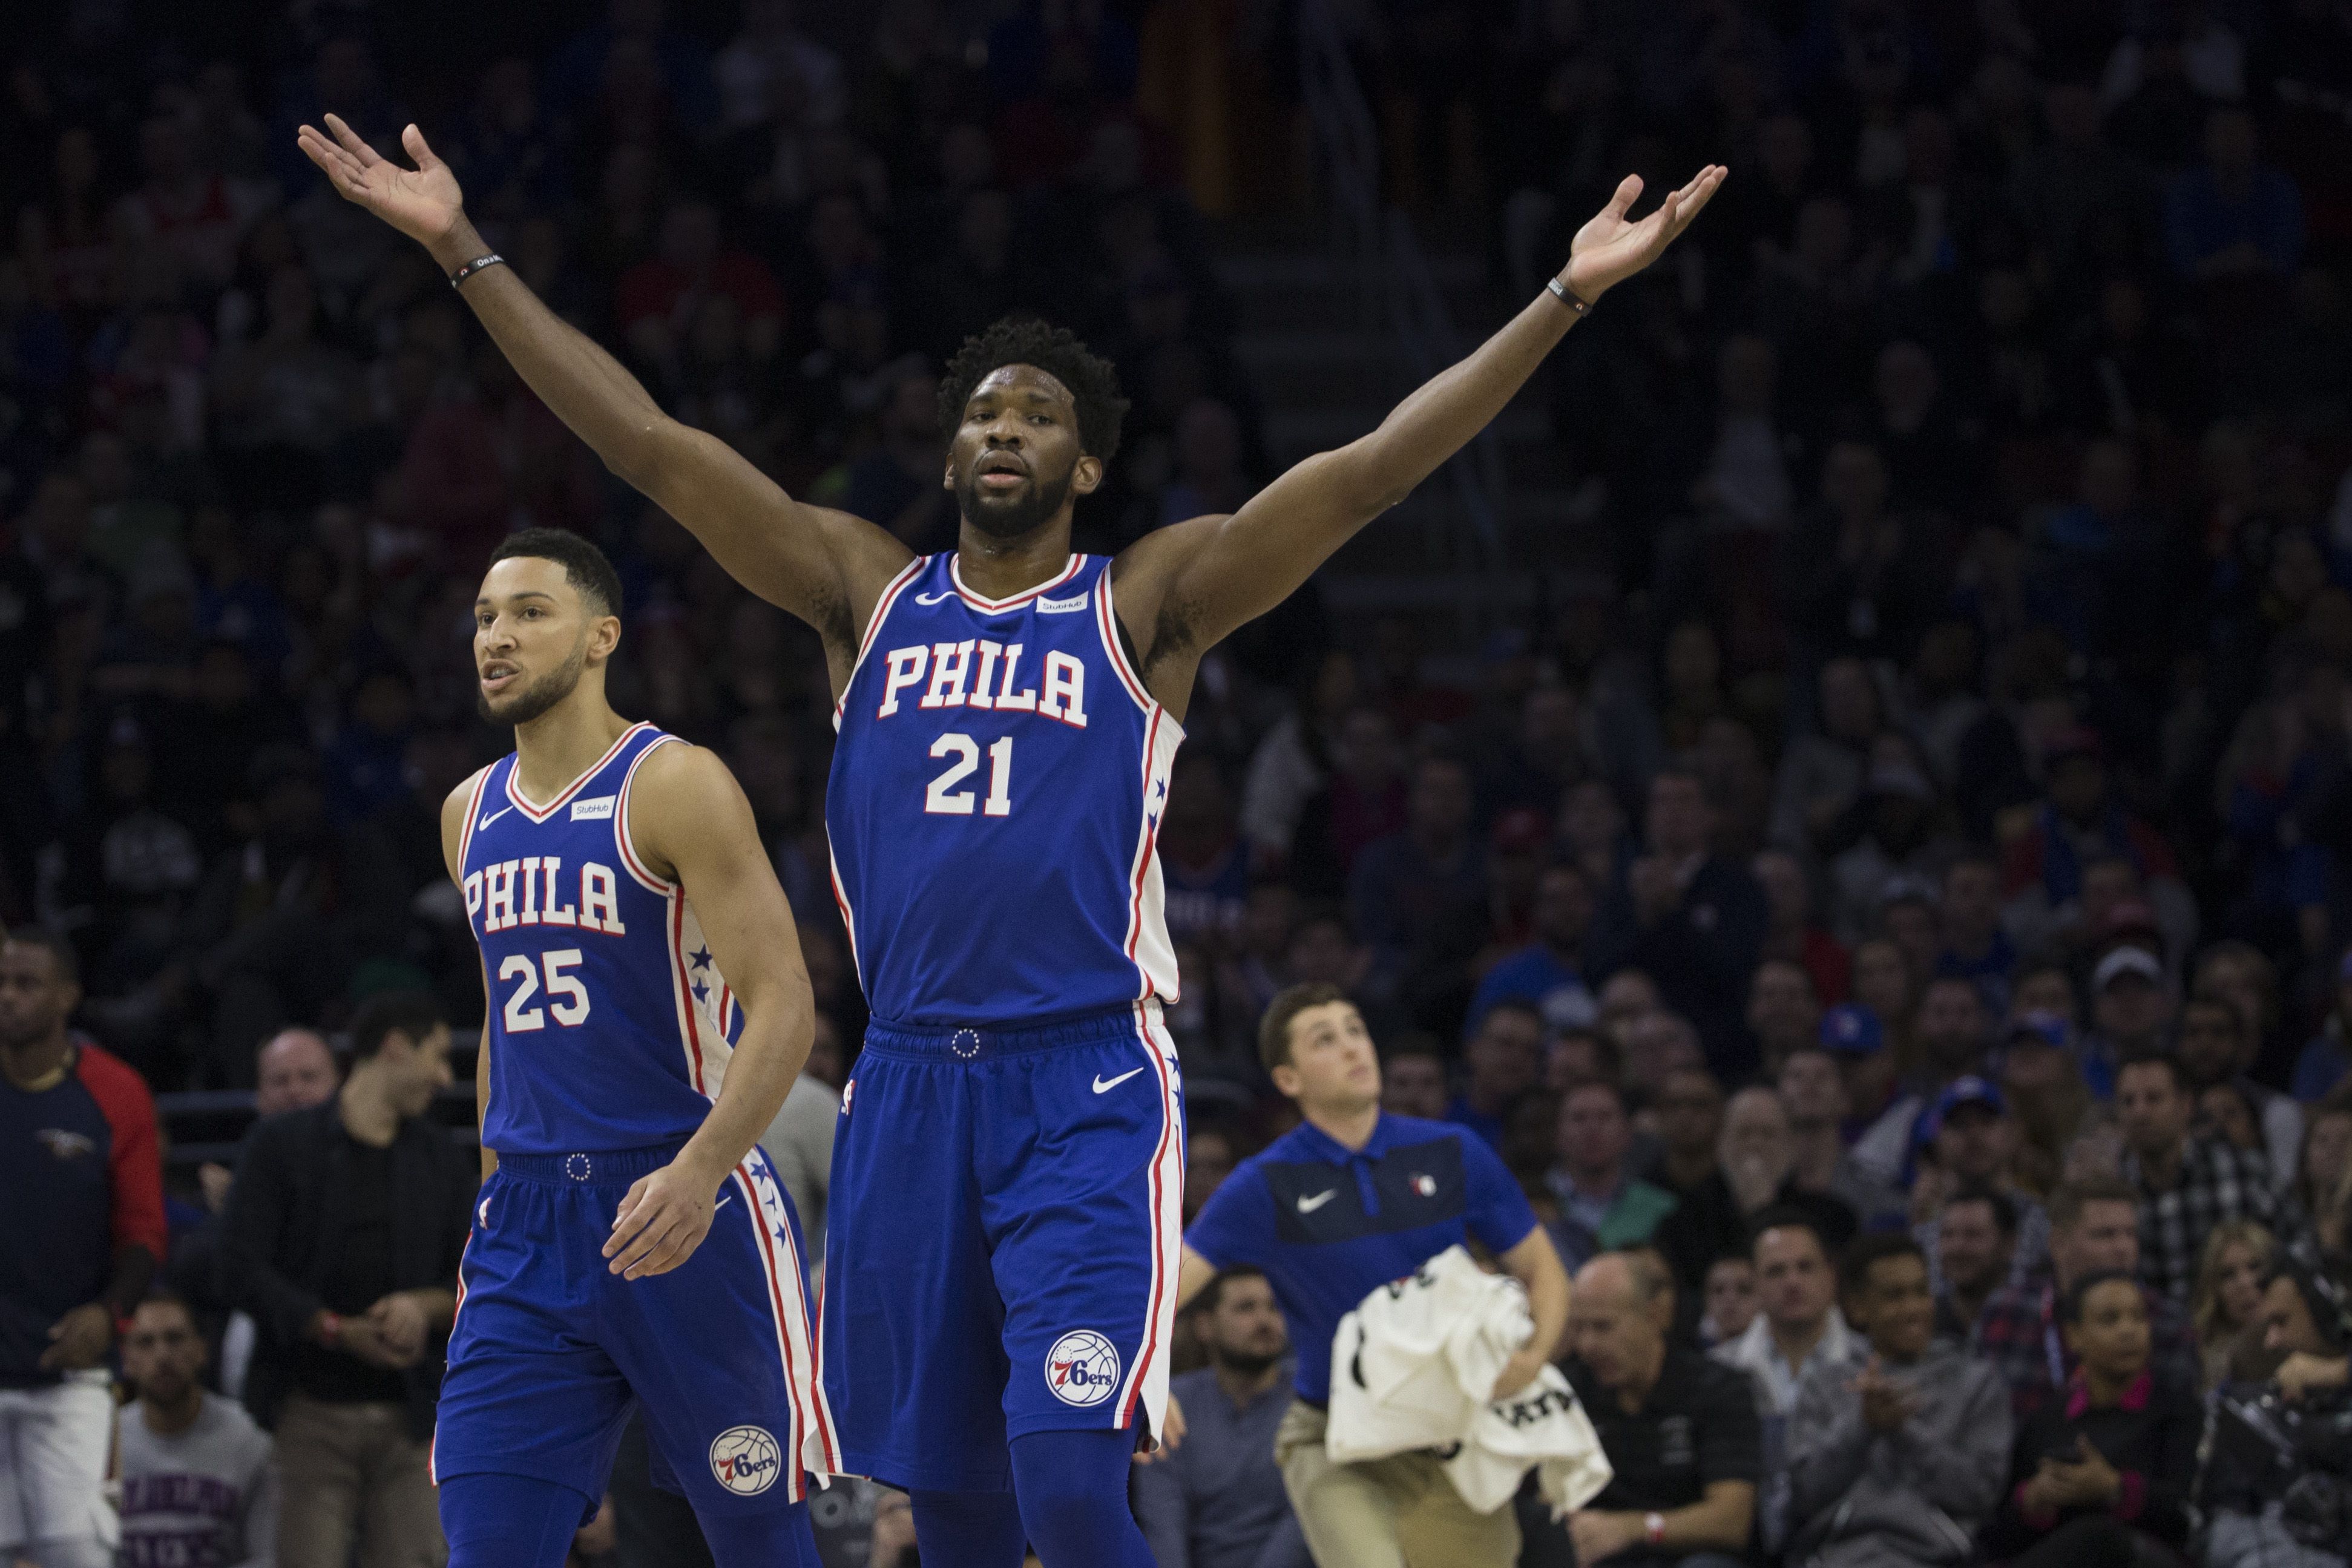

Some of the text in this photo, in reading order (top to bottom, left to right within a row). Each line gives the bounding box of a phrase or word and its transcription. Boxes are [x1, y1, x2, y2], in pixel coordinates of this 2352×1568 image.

[1042, 601, 1082, 610] StubHub
[876, 638, 1088, 729] PHILA
[924, 733, 1013, 816] 21
[576, 804, 609, 815] StubHub
[462, 856, 626, 938] PHILA
[499, 948, 590, 1034] 25
[1054, 1359, 1113, 1386] 76ers
[717, 1455, 776, 1481] 76ers
